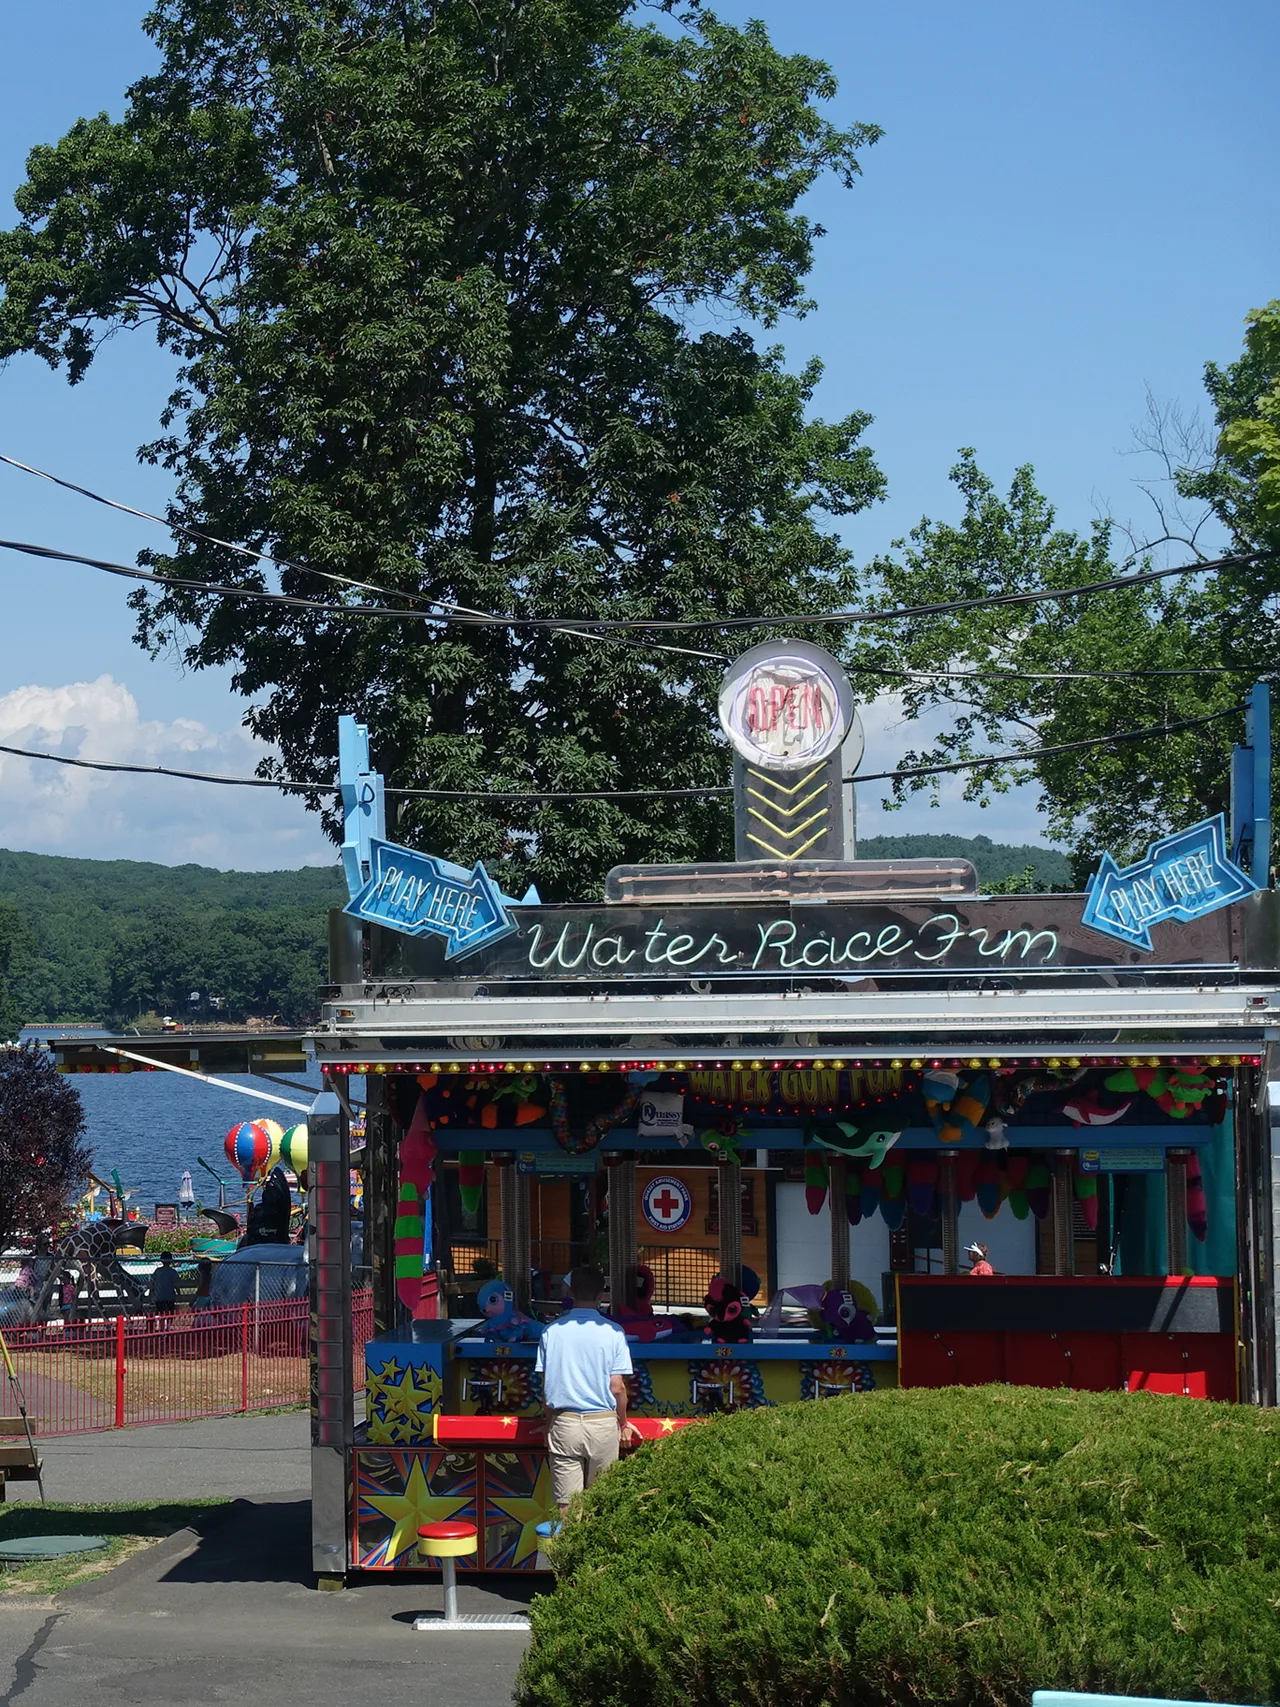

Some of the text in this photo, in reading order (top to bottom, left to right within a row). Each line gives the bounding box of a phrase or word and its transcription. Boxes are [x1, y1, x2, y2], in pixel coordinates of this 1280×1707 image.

[749, 684, 822, 732] OPEN
[378, 866, 483, 930] PLAY HERE
[1110, 850, 1220, 925] PLAY HERE
[526, 918, 738, 968] Water
[752, 919, 912, 969] Race
[689, 1071, 770, 1102] WATER
[779, 1071, 839, 1103] GUN
[640, 1101, 680, 1127] Quassy
